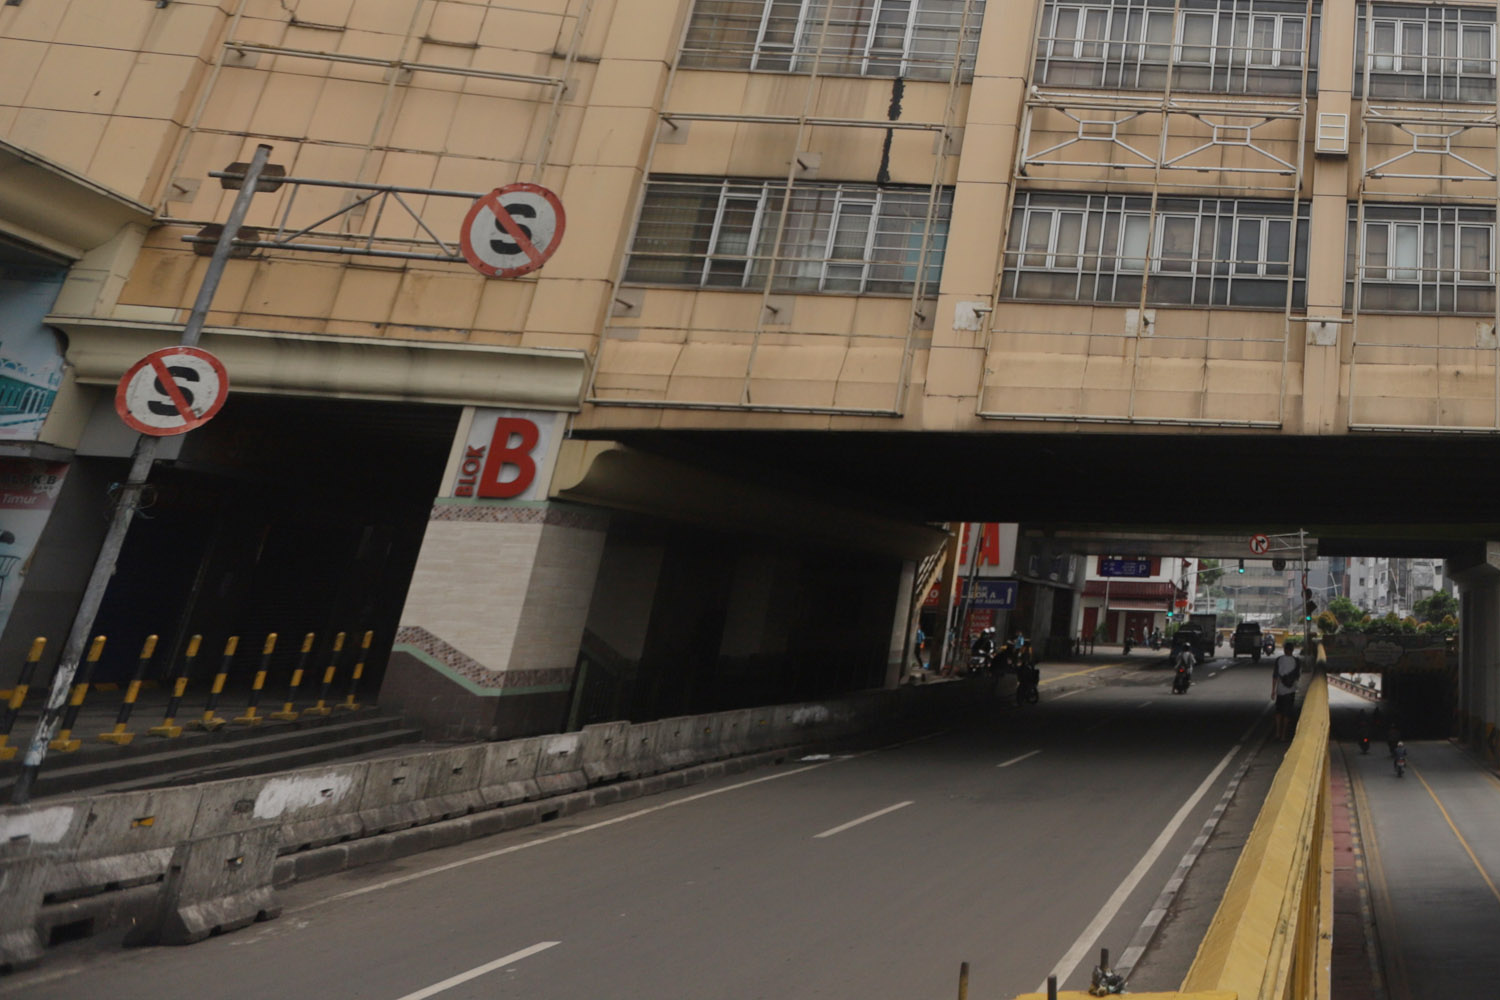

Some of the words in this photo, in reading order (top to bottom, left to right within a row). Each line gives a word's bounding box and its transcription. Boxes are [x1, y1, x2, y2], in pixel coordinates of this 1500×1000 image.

[490, 203, 537, 255] S
[147, 366, 200, 416] S
[454, 445, 486, 498] BLOK
[477, 416, 540, 499] B
[2, 493, 38, 505] Timur
